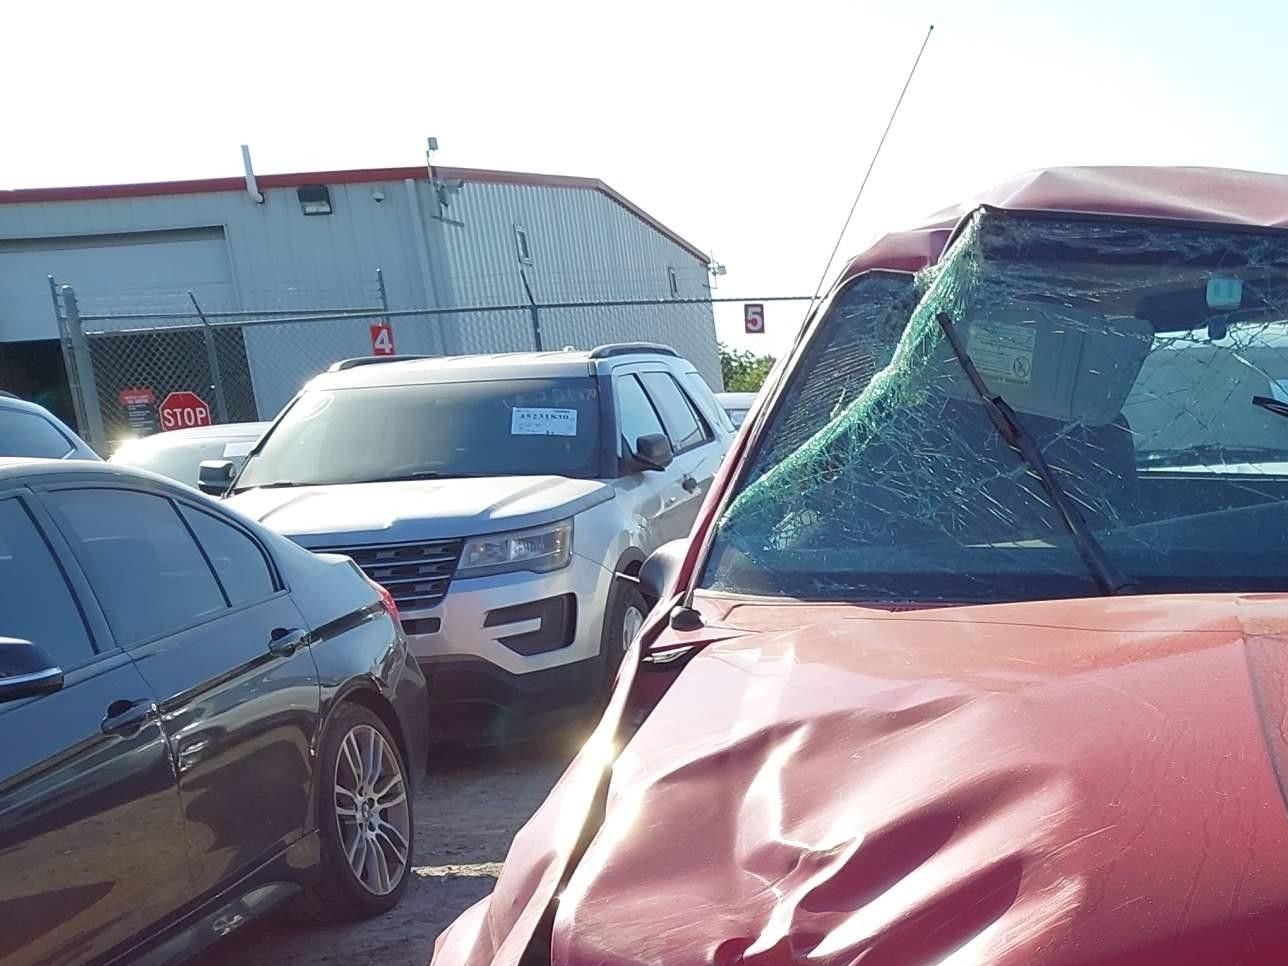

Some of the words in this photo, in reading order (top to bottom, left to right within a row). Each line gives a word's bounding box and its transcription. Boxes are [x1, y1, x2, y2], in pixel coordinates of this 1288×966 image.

[747, 307, 762, 331] 5
[375, 329, 392, 353] 4
[163, 407, 207, 427] STOP
